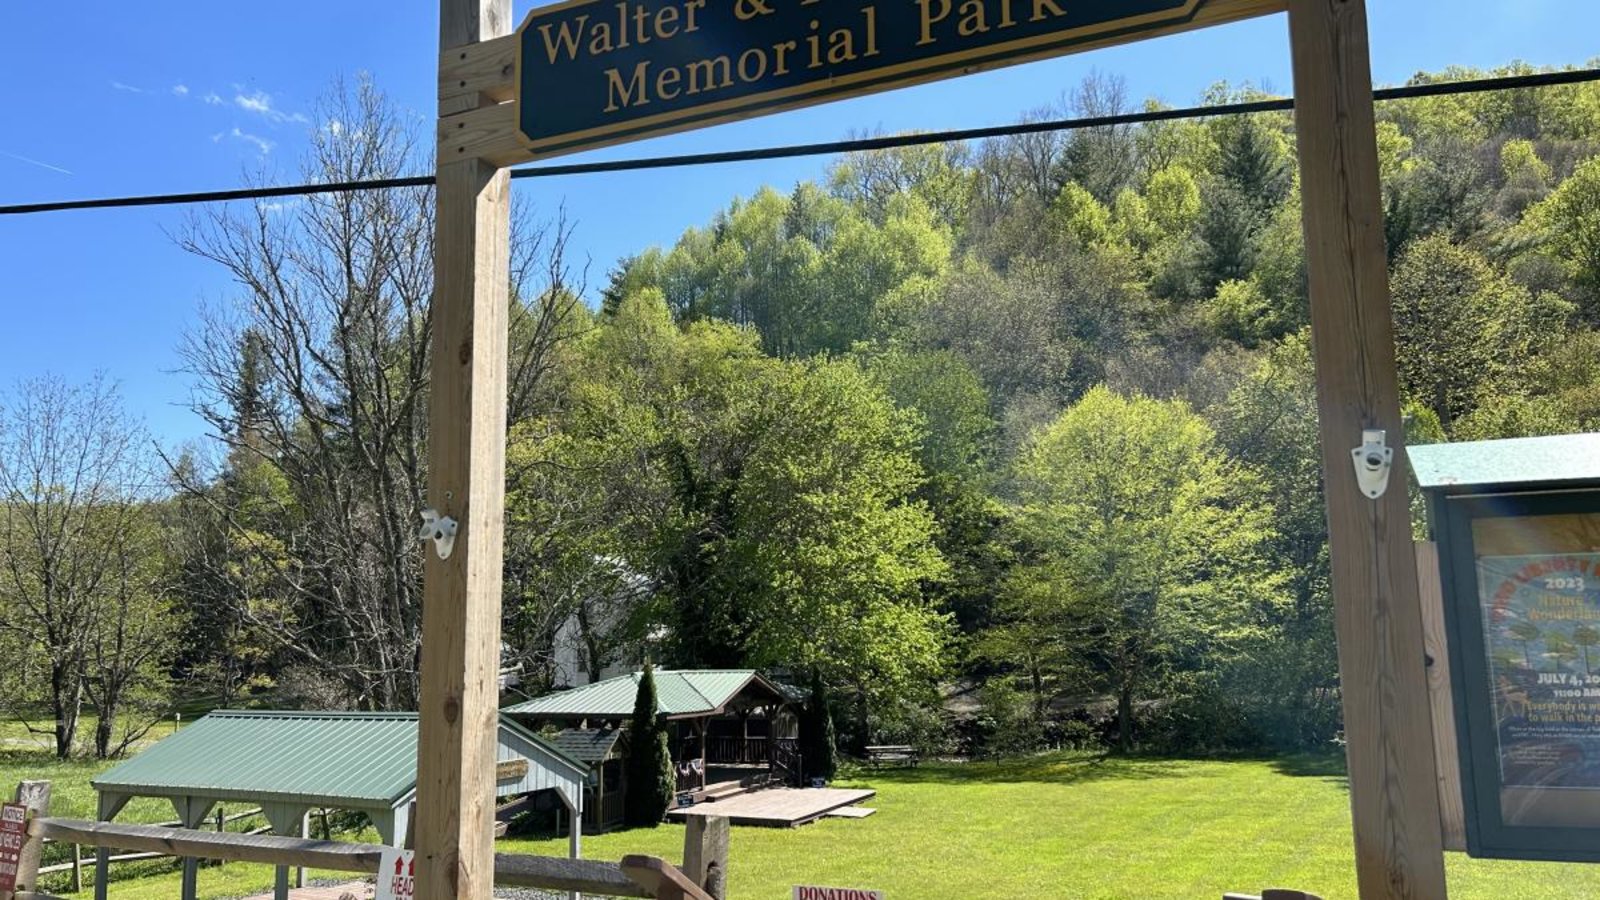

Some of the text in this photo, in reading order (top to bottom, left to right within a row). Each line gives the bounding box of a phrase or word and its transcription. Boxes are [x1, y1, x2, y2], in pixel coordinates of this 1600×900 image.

[538, 0, 706, 65] Walter
[603, 6, 880, 113] Memorial
[1544, 576, 1585, 592] 2023
[1537, 673, 1568, 684] JULY
[1569, 675, 1583, 687] 4,
[1527, 702, 1577, 714] Everybody
[1578, 702, 1586, 711] is
[1528, 712, 1538, 722] to
[1540, 711, 1562, 722] walk
[1565, 711, 1575, 722] in
[1577, 712, 1593, 722] the
[4, 806, 24, 822] NOTICE
[391, 876, 414, 896] HEAD
[799, 886, 877, 900] DONATIONS
